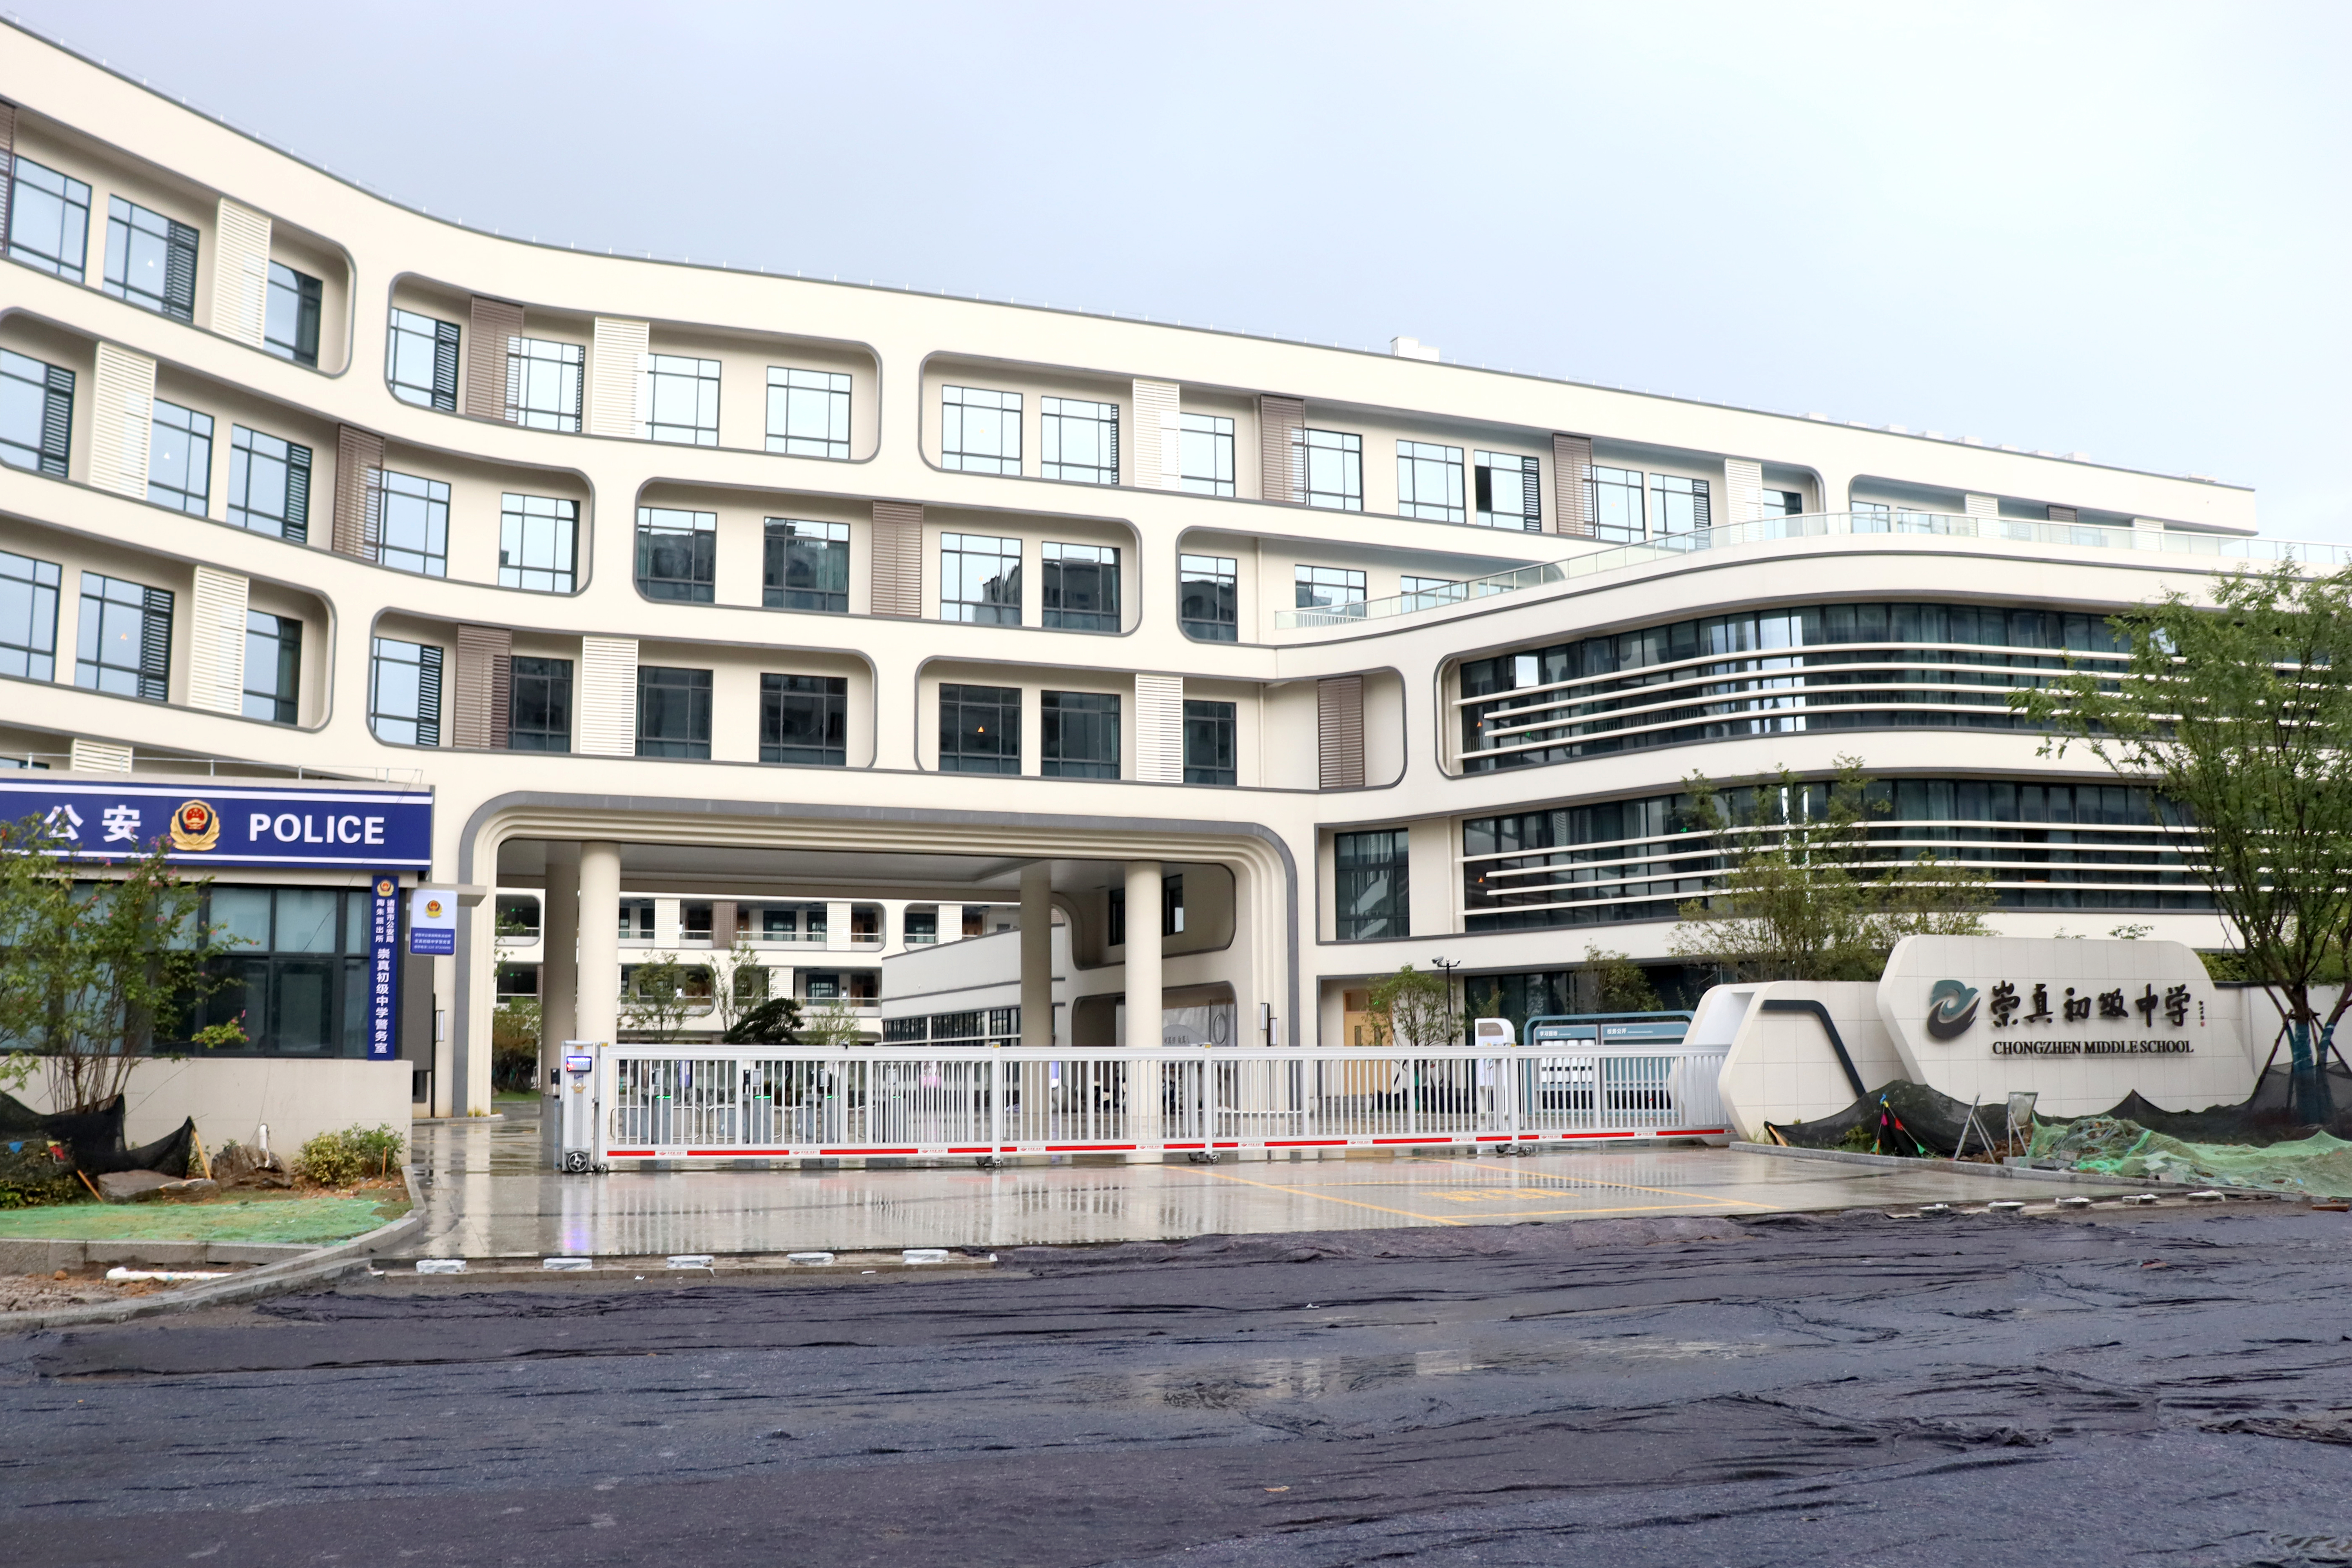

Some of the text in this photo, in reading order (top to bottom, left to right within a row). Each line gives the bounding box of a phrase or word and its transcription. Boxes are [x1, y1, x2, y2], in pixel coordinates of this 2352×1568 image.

[43, 804, 141, 842] 公安
[249, 813, 385, 844] POLICE
[375, 899, 385, 943] 陶朱派出所
[386, 899, 395, 943] 诸暨市公安局
[374, 948, 390, 1054] 崇真初级中学警务室
[1991, 980, 2190, 1027] 崇真初级中学
[1993, 1041, 2194, 1054] CHONGZHEN MIDDLE SCHOOL
